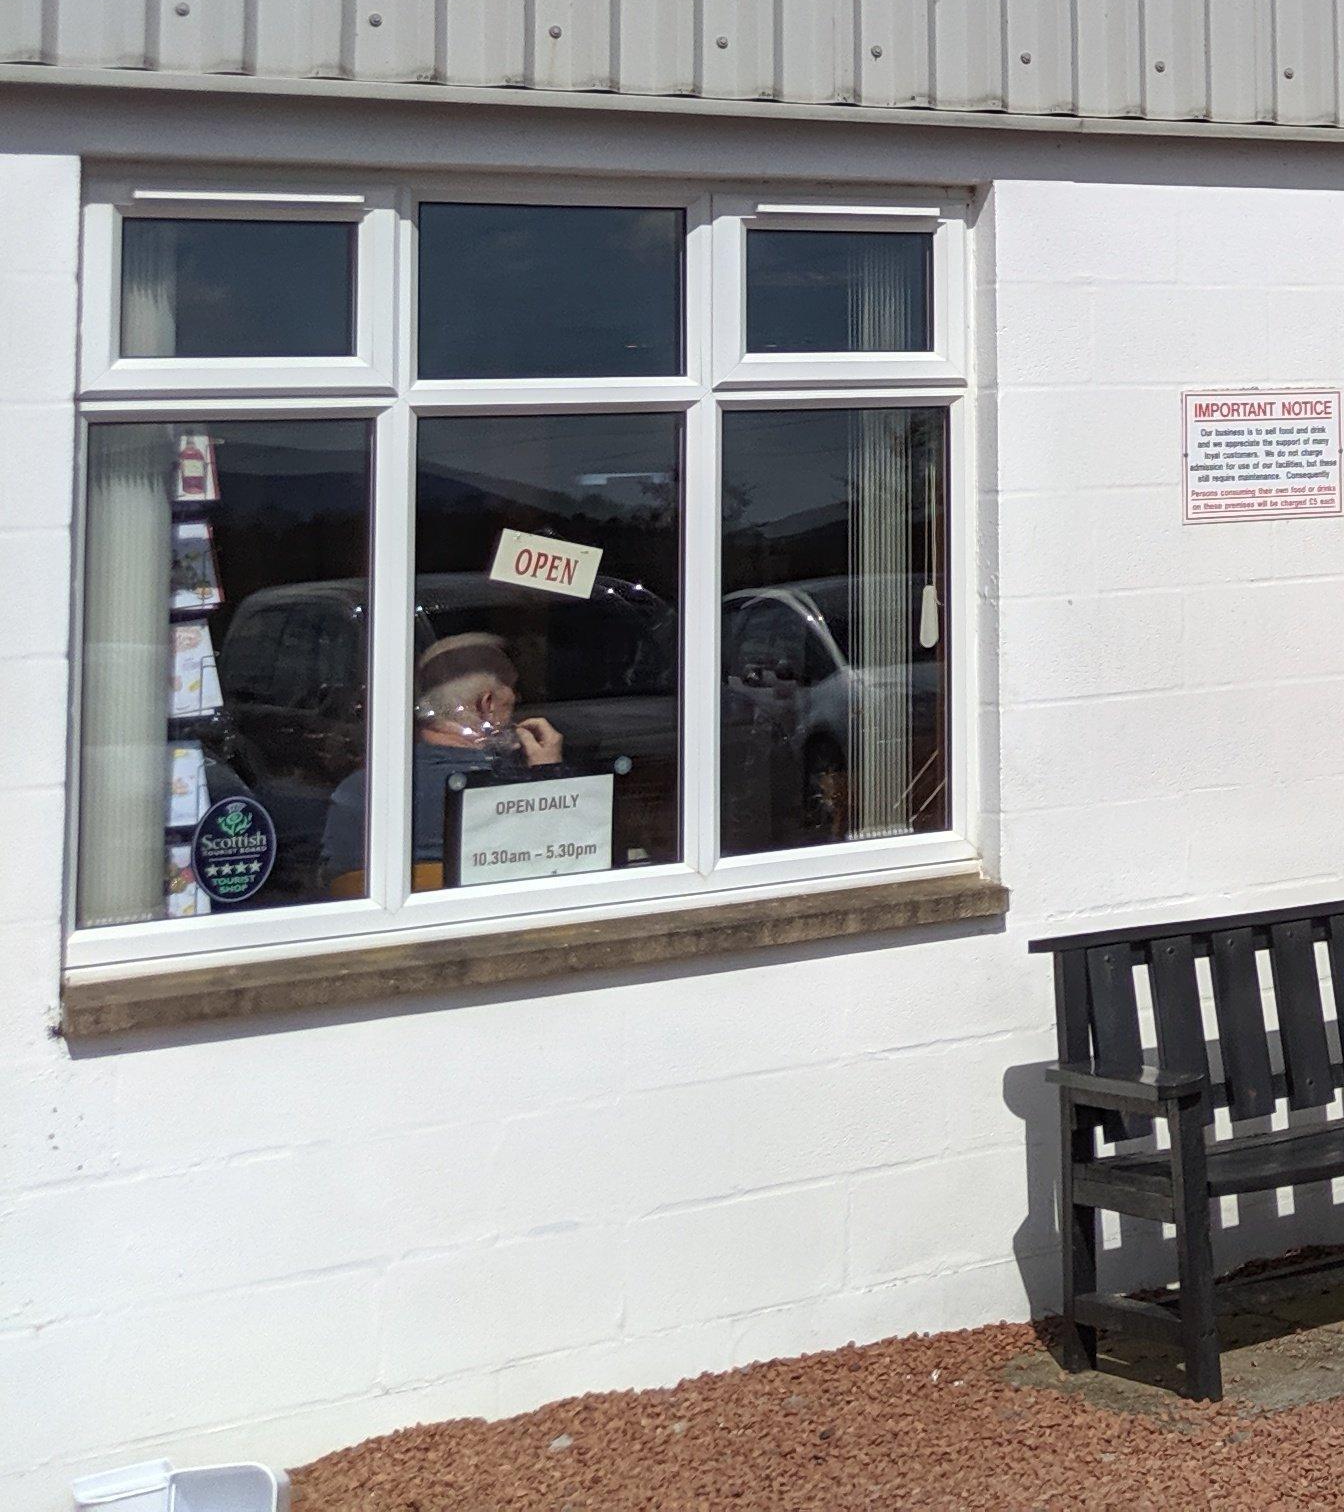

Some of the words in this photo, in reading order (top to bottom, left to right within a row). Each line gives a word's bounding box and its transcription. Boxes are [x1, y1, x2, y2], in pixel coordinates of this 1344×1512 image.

[1194, 402, 1276, 418] IMPORTANT
[1281, 400, 1332, 416] NOTICE
[1200, 428, 1213, 437] Our
[1214, 428, 1245, 437] business
[1296, 426, 1309, 434] and
[1275, 438, 1301, 448] support
[514, 547, 580, 586] OPEN
[495, 798, 536, 816] OPEN
[538, 792, 580, 811] DAILY
[202, 831, 267, 849] Scottish
[471, 848, 531, 868] 10.30am
[545, 841, 598, 865] 5.30pm
[212, 874, 256, 886] TOURIST
[219, 884, 248, 893] SHOP
